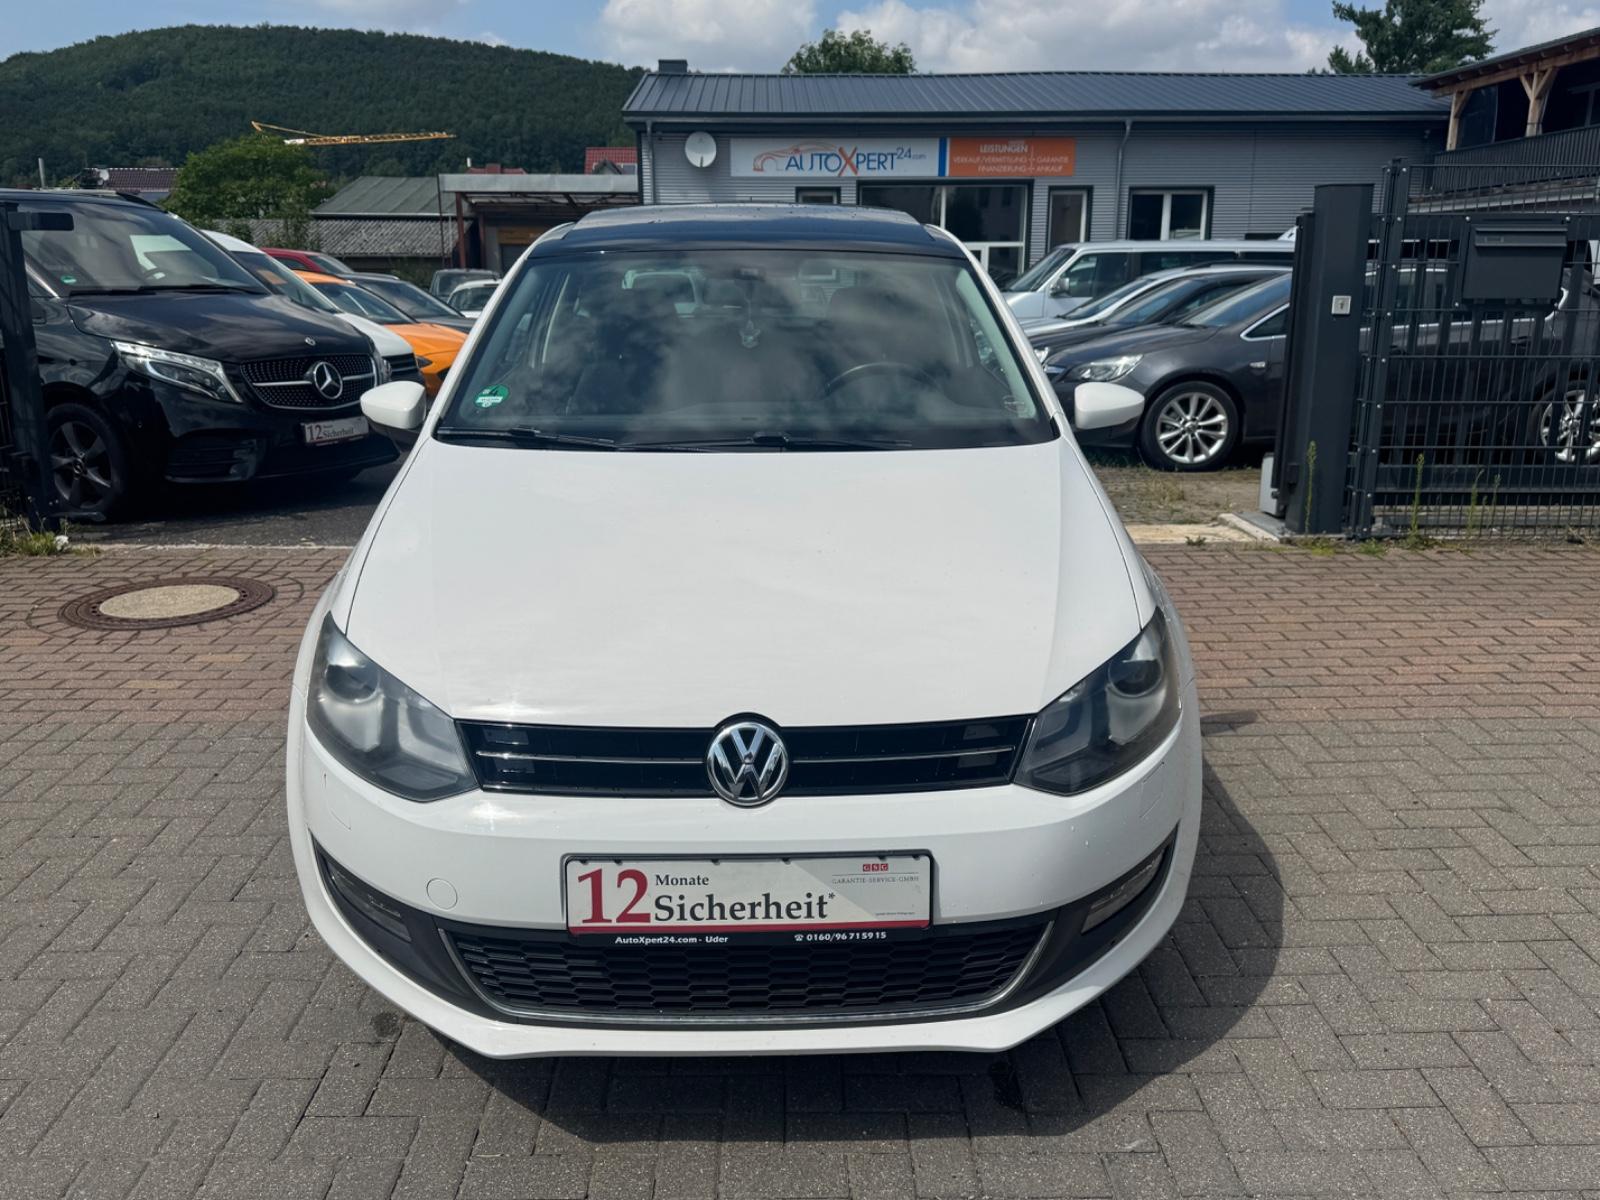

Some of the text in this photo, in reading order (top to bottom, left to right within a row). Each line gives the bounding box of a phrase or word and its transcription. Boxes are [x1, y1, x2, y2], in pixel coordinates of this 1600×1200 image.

[980, 144, 1028, 153] LEISTUNGEN
[306, 424, 323, 442] 12
[655, 874, 709, 886] Monate
[578, 868, 651, 923] 12
[705, 935, 729, 944] Uder
